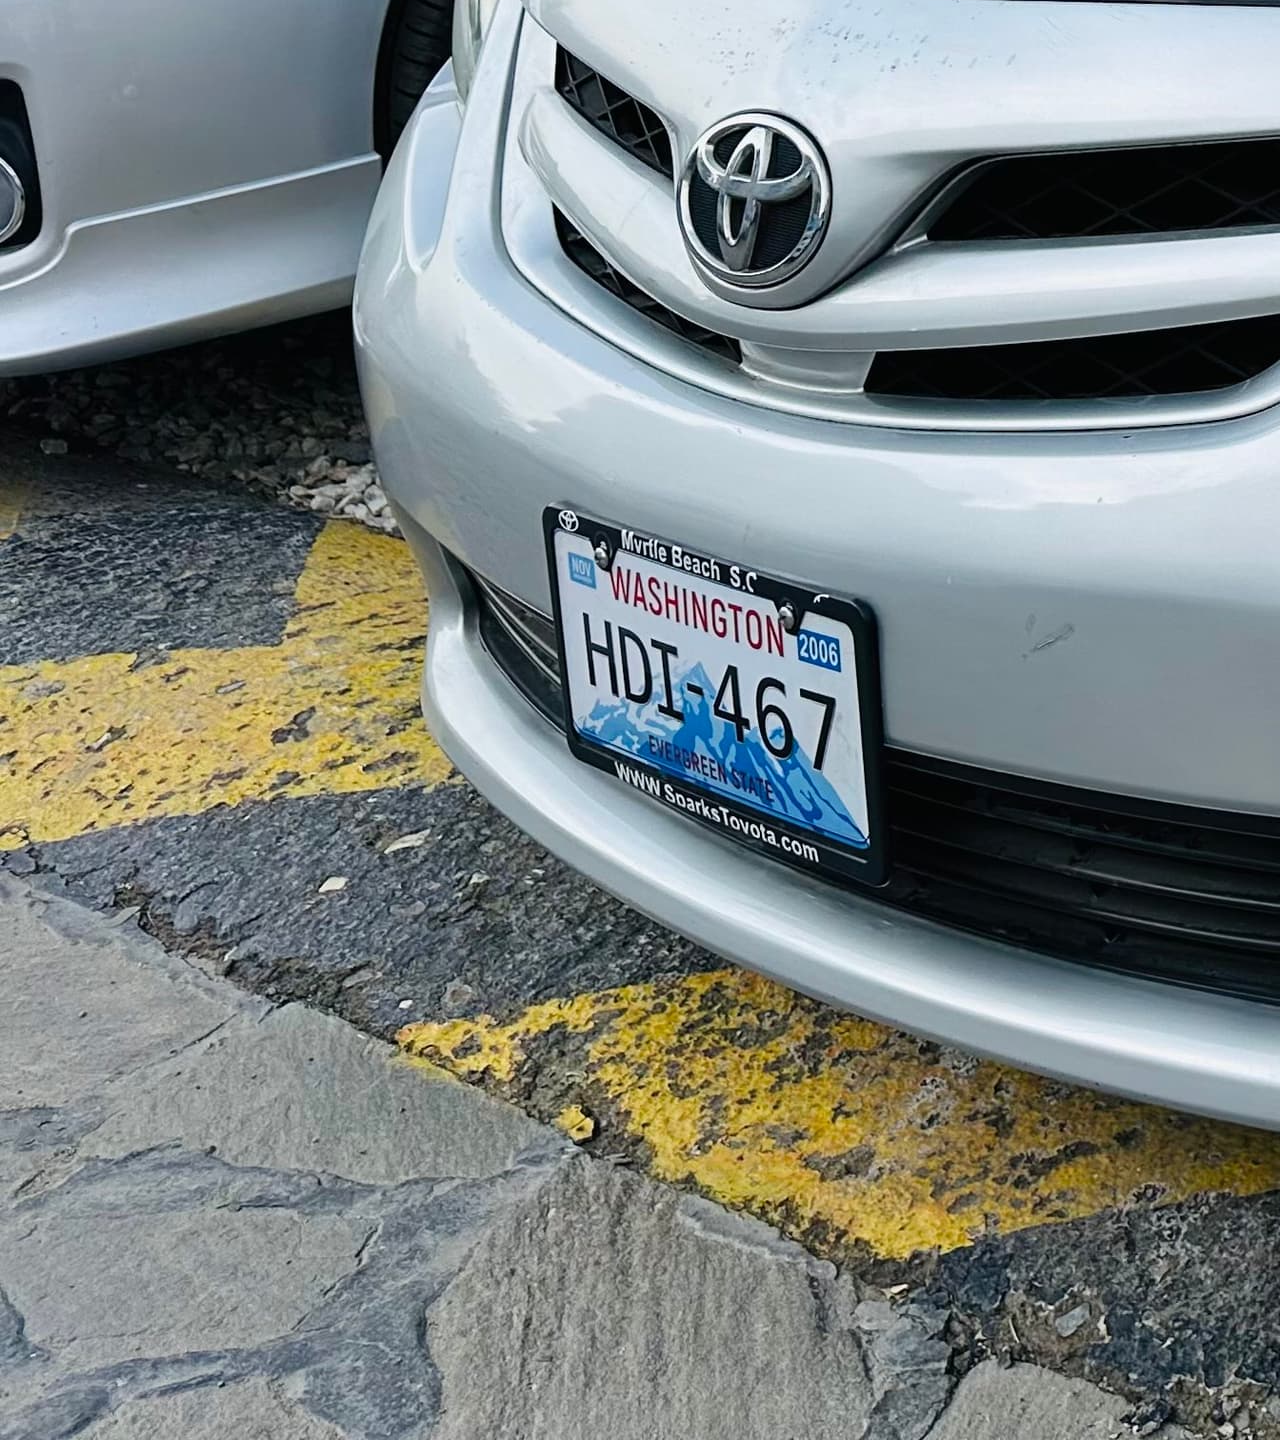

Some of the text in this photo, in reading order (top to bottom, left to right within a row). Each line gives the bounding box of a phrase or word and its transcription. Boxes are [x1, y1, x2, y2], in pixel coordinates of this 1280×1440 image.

[571, 556, 592, 577] NOV
[671, 544, 720, 581] Beach
[609, 565, 785, 658] WASHINGTON
[799, 633, 839, 667] 2006
[582, 612, 836, 771] HDI-467
[649, 735, 775, 803] EVERGREEN STATE
